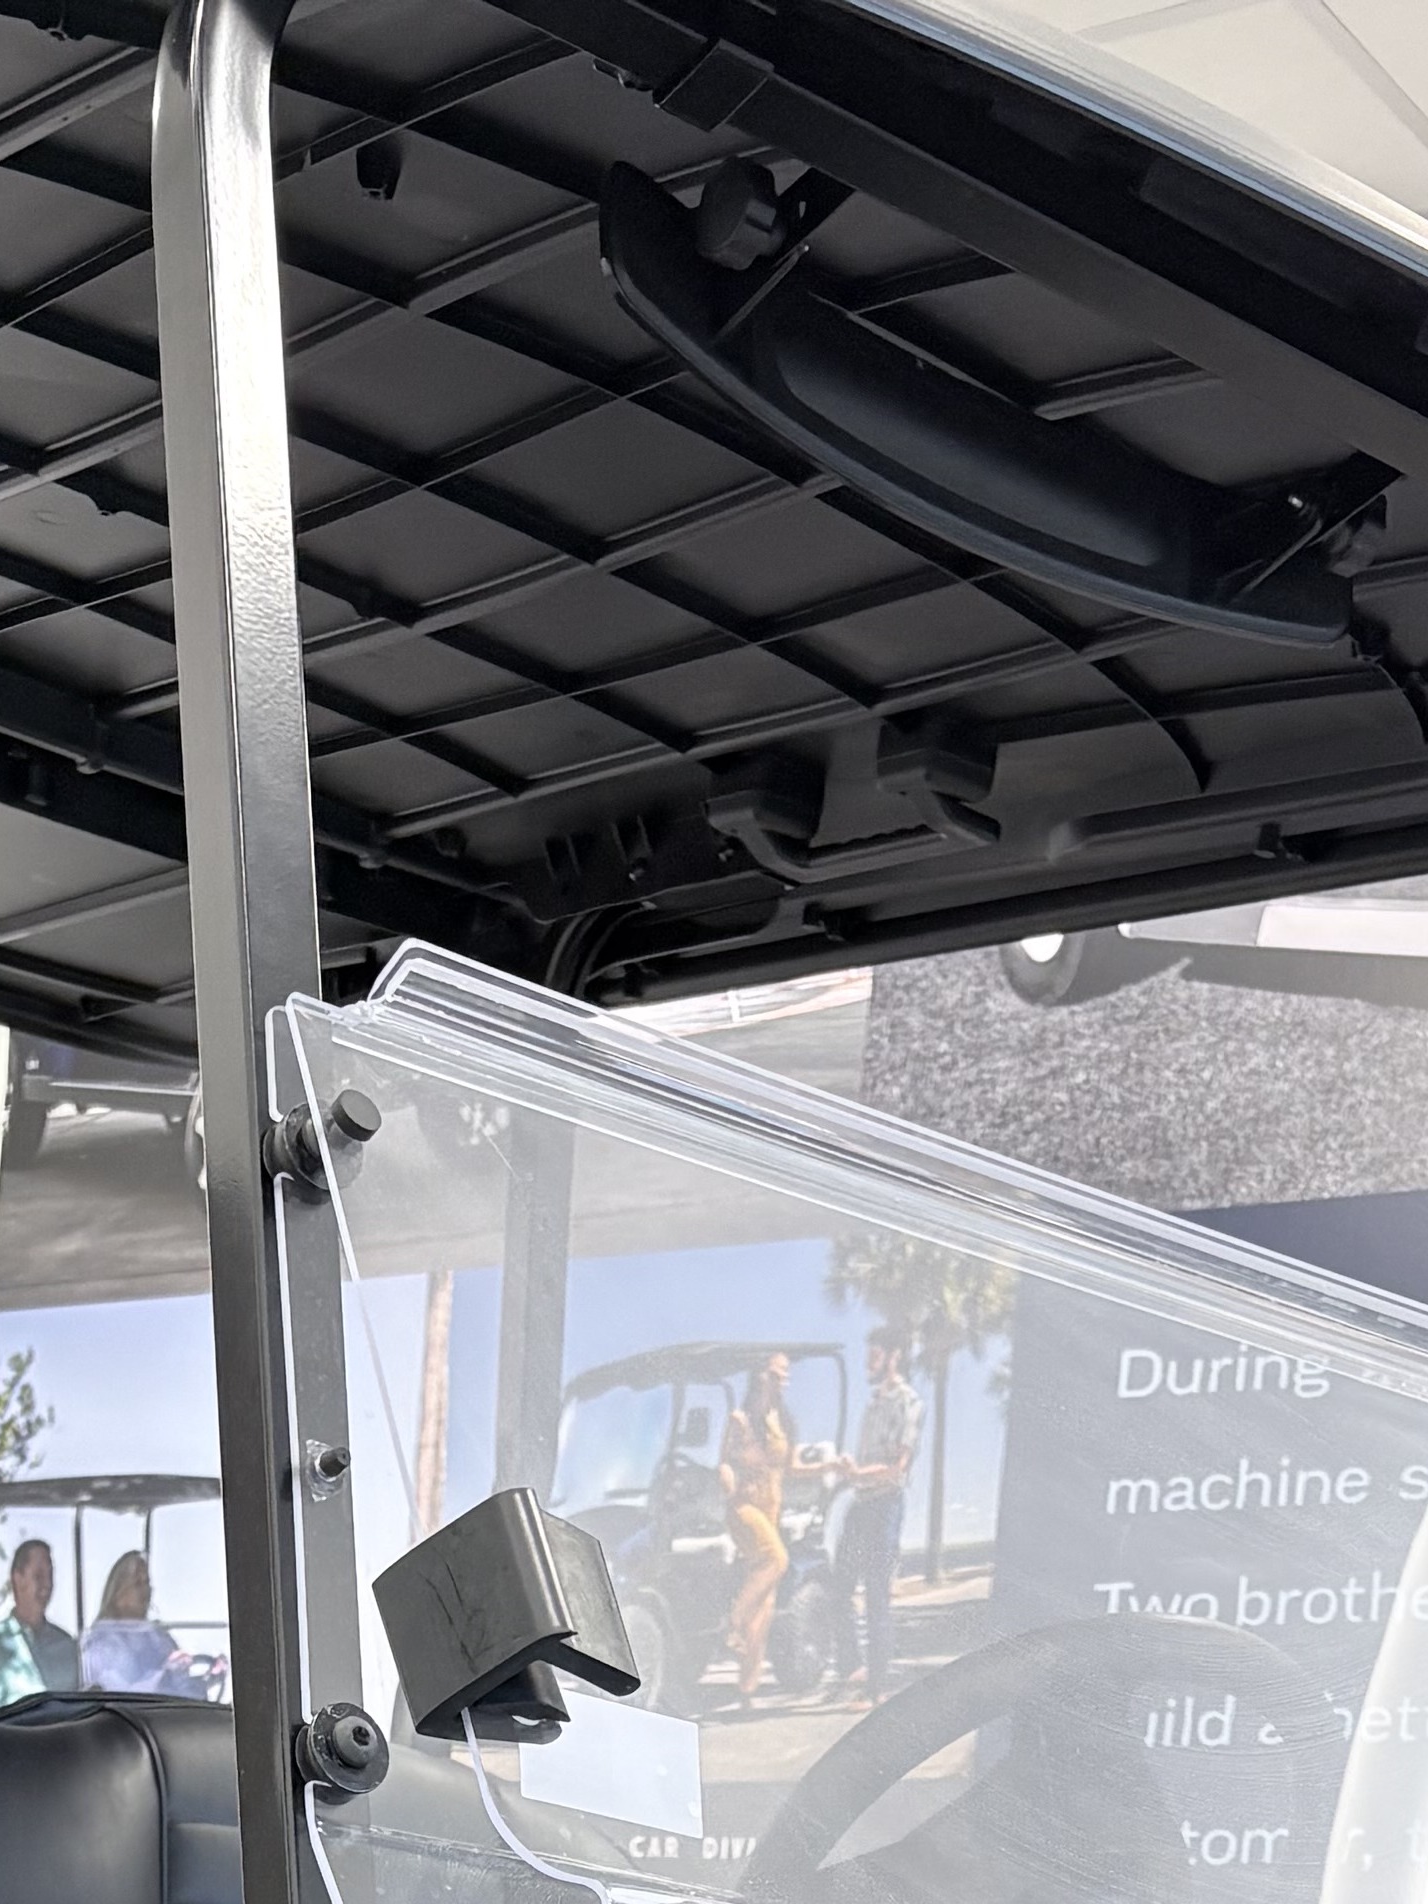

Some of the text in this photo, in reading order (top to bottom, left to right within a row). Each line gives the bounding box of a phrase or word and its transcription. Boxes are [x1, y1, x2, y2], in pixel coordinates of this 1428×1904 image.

[1117, 1341, 1331, 1400] During
[1105, 1455, 1371, 1515] machine
[628, 1835, 680, 1859] CAR
